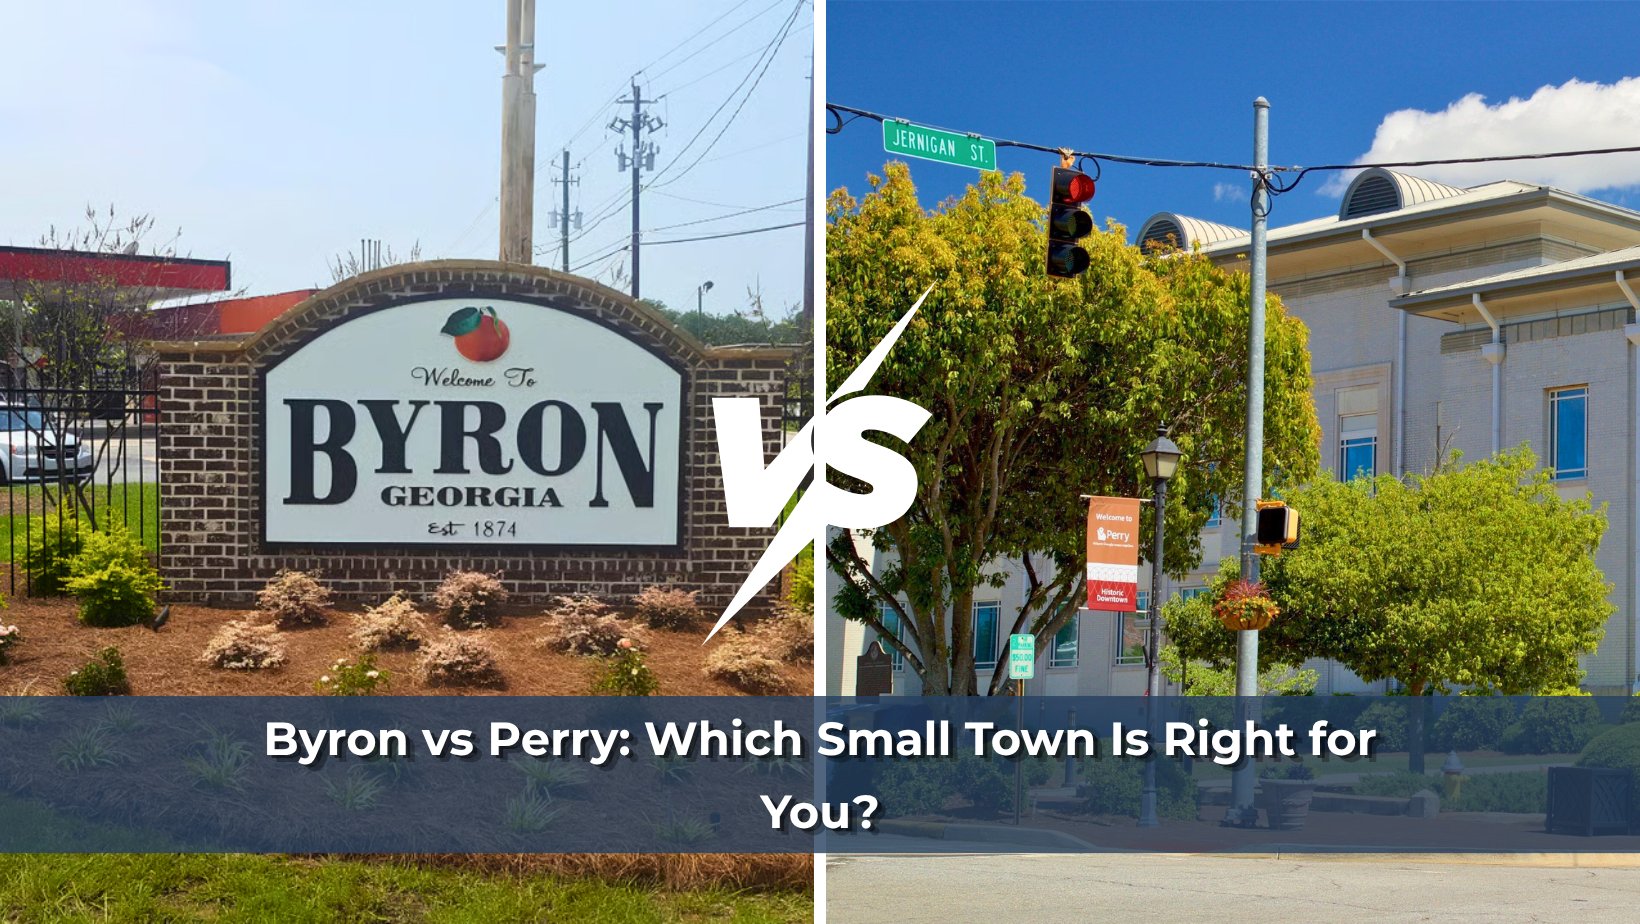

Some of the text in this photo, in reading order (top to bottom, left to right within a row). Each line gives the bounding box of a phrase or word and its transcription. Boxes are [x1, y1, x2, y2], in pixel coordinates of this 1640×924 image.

[893, 129, 988, 163] JERNIGAN ST.
[411, 367, 537, 388] Welcome To
[283, 398, 663, 508] BYRON
[380, 485, 563, 507] GEORGIA
[1096, 513, 1125, 521] Welcome
[428, 520, 516, 538] Est 1874
[1106, 530, 1130, 543] Perry
[1097, 595, 1128, 603] Downtown
[1101, 588, 1124, 597] Historic
